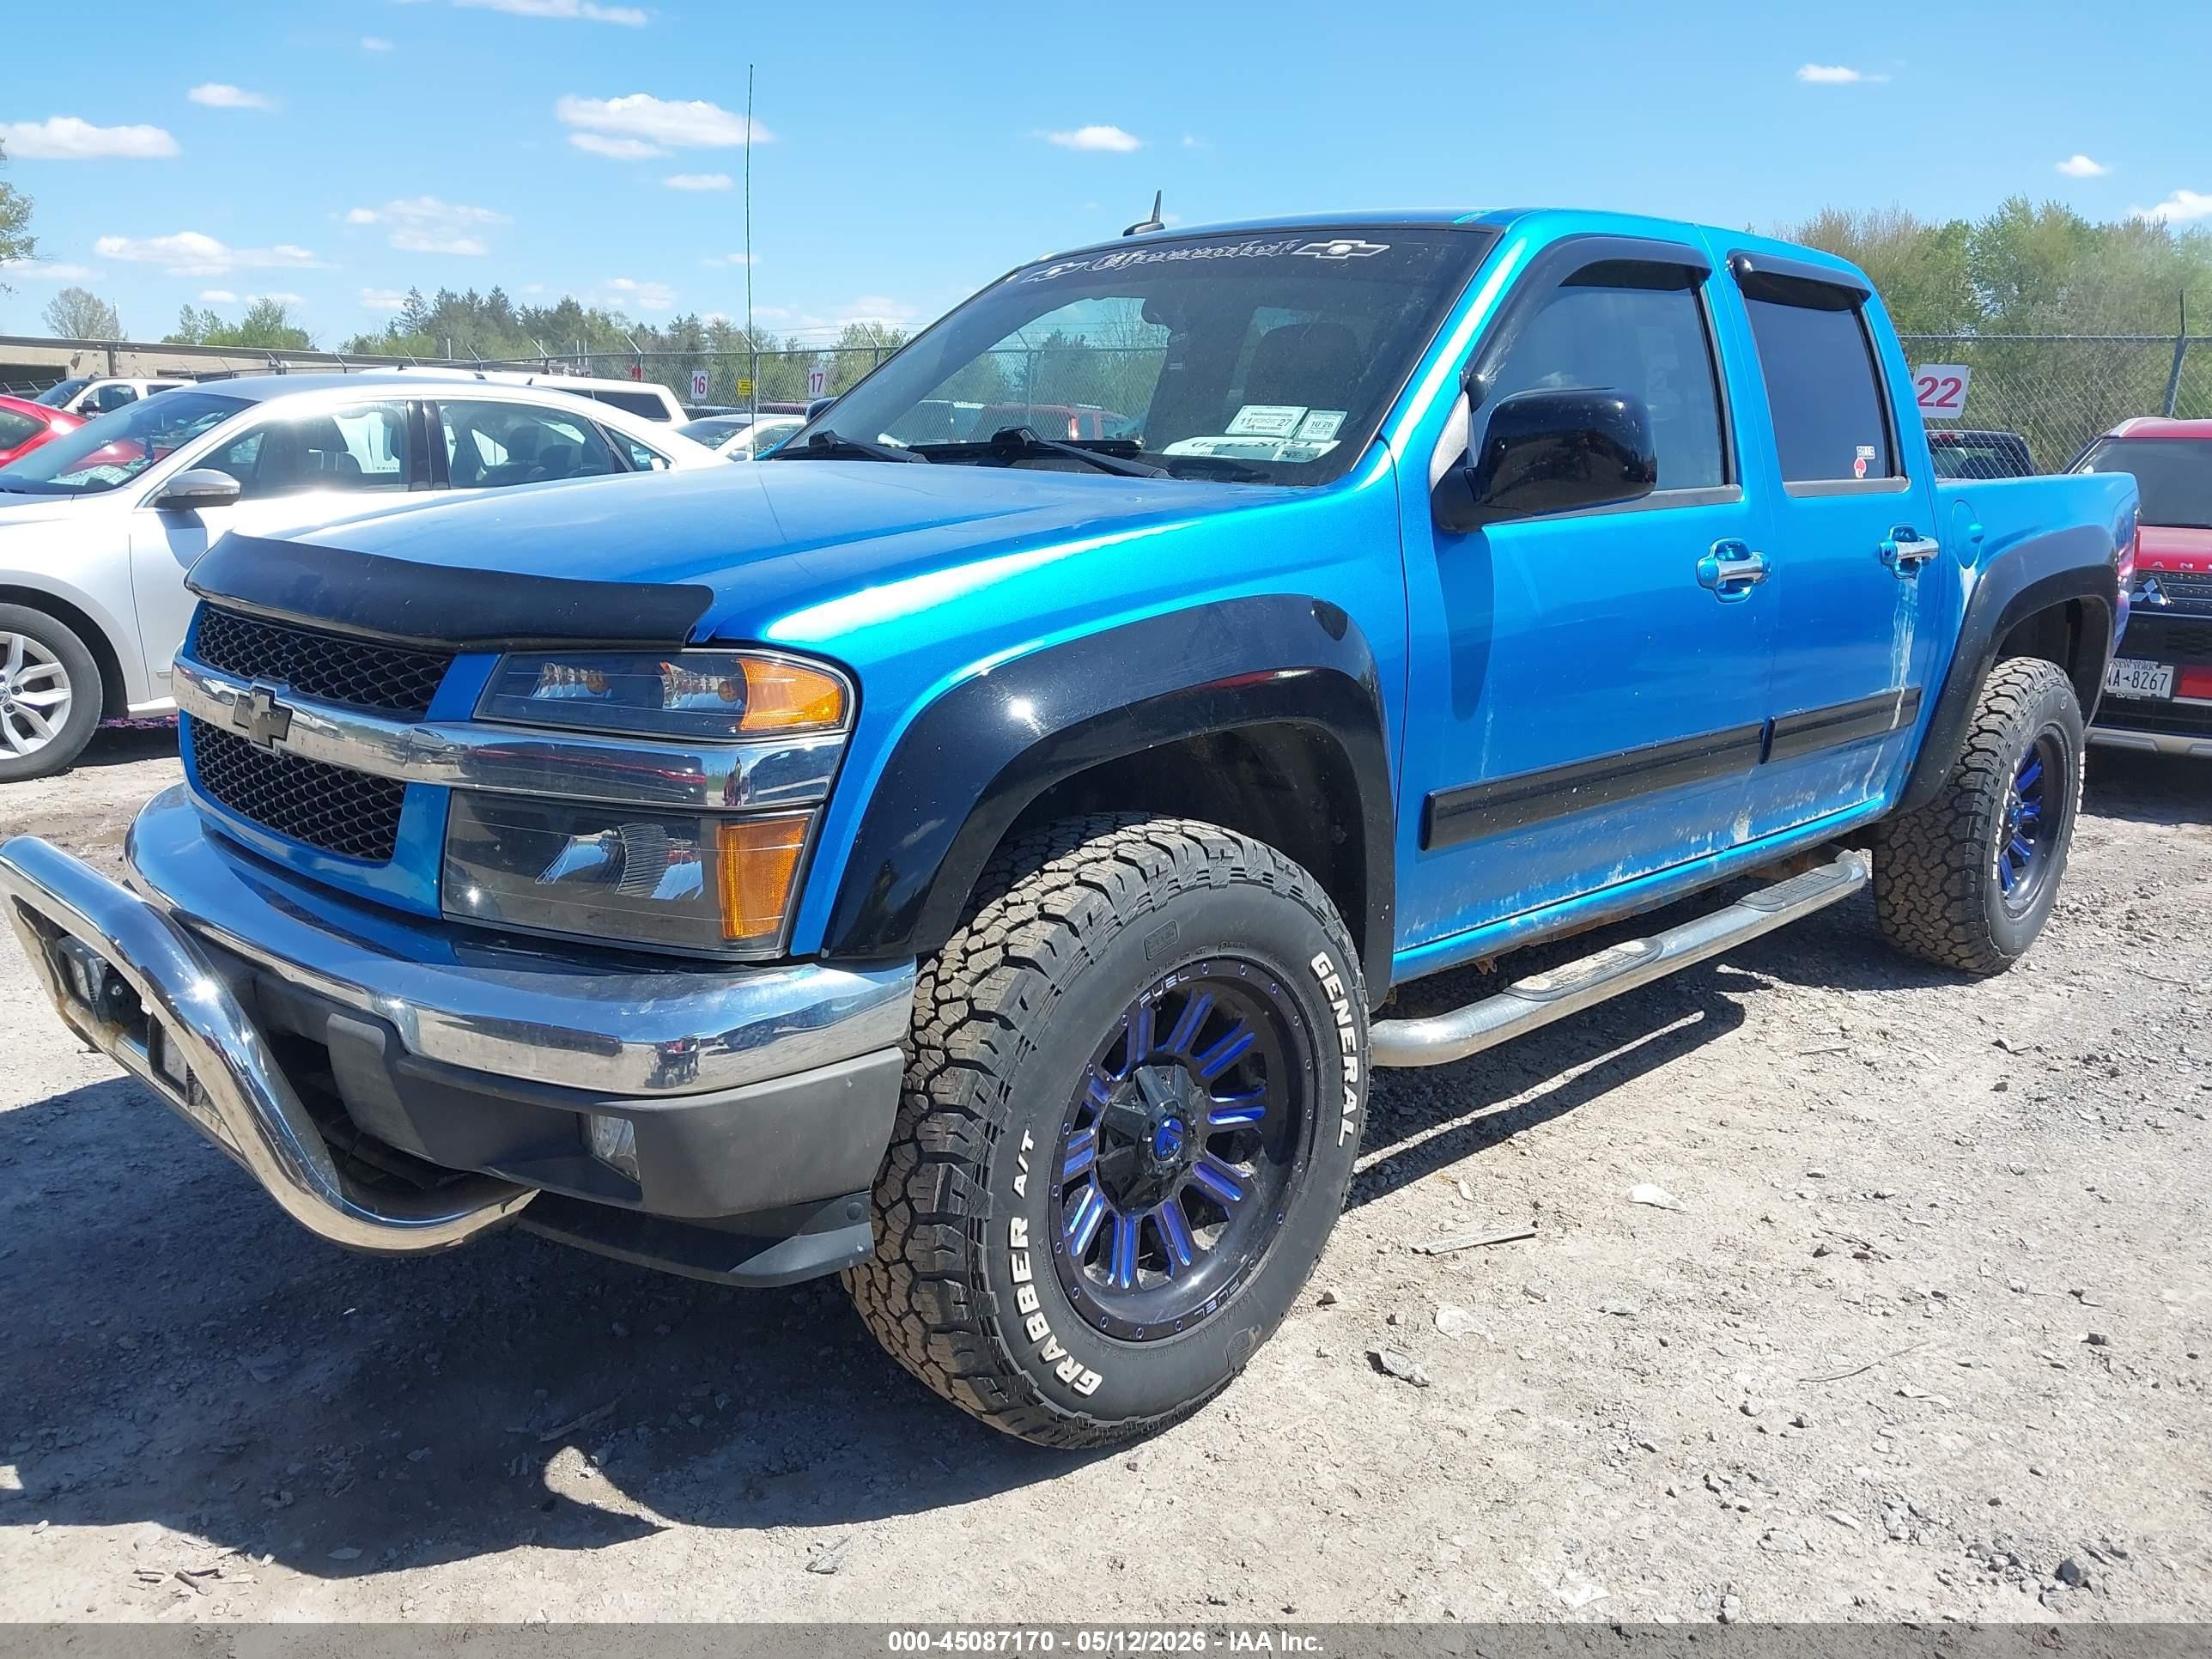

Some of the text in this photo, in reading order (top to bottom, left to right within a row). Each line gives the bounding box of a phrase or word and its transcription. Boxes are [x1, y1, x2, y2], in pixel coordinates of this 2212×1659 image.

[693, 376, 706, 394] 16
[810, 373, 823, 393] 17
[1917, 376, 1962, 408] 22
[1277, 418, 1292, 427] 27
[1857, 447, 1875, 458] BILLS
[2112, 659, 2154, 671] NEW YORK
[1139, 971, 1190, 1009] FUEL
[1310, 951, 1358, 1147] GENERAL
[1010, 1128, 1103, 1388] GRABBER A/T
[1194, 1277, 1240, 1318] FUEL
